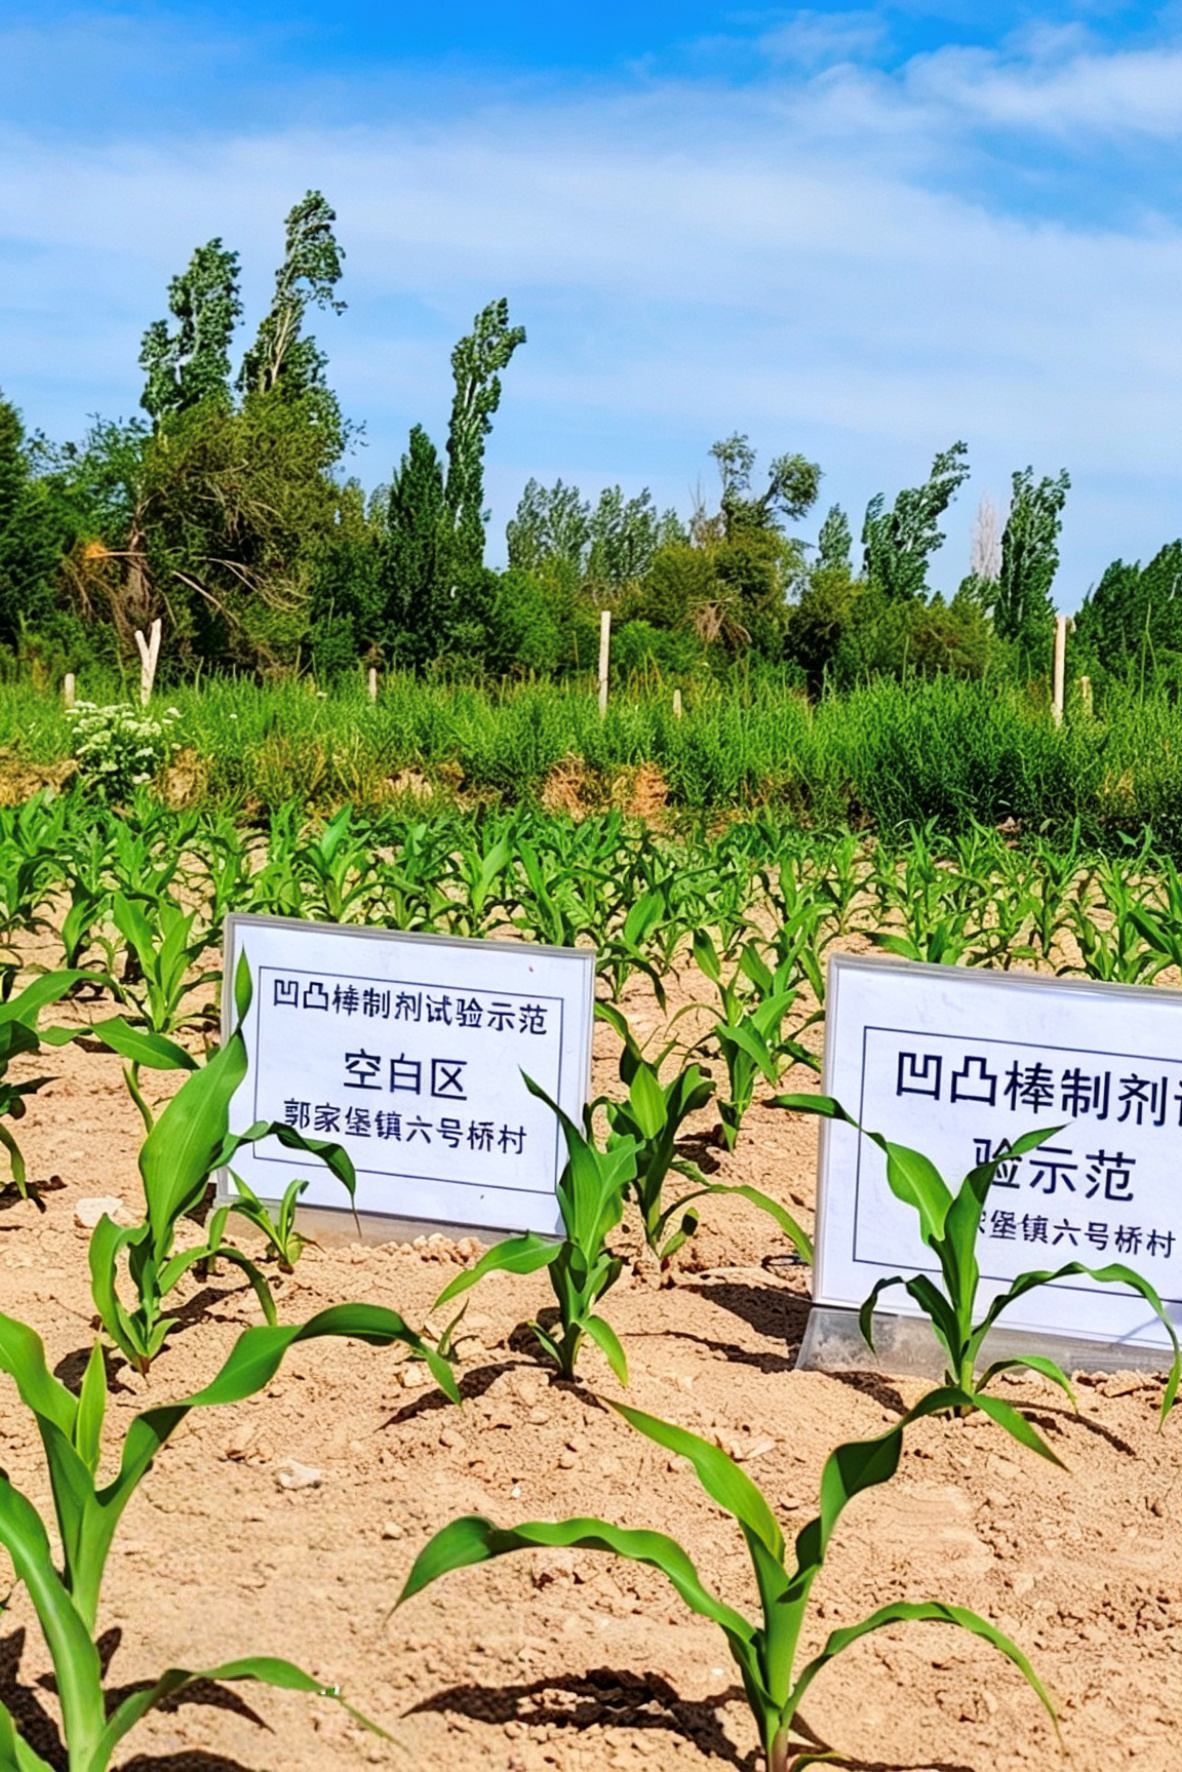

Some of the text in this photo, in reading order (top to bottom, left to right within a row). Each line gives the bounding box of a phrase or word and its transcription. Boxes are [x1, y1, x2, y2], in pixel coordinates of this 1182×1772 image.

[273, 979, 548, 1036] 凹凸棒制剂试验示范
[343, 1048, 468, 1101] 空白区
[284, 1098, 527, 1154] 郭家堡镇六号桥村
[972, 1138, 1136, 1202] 验示范
[979, 1209, 1176, 1259] 堡镇六号桥村
